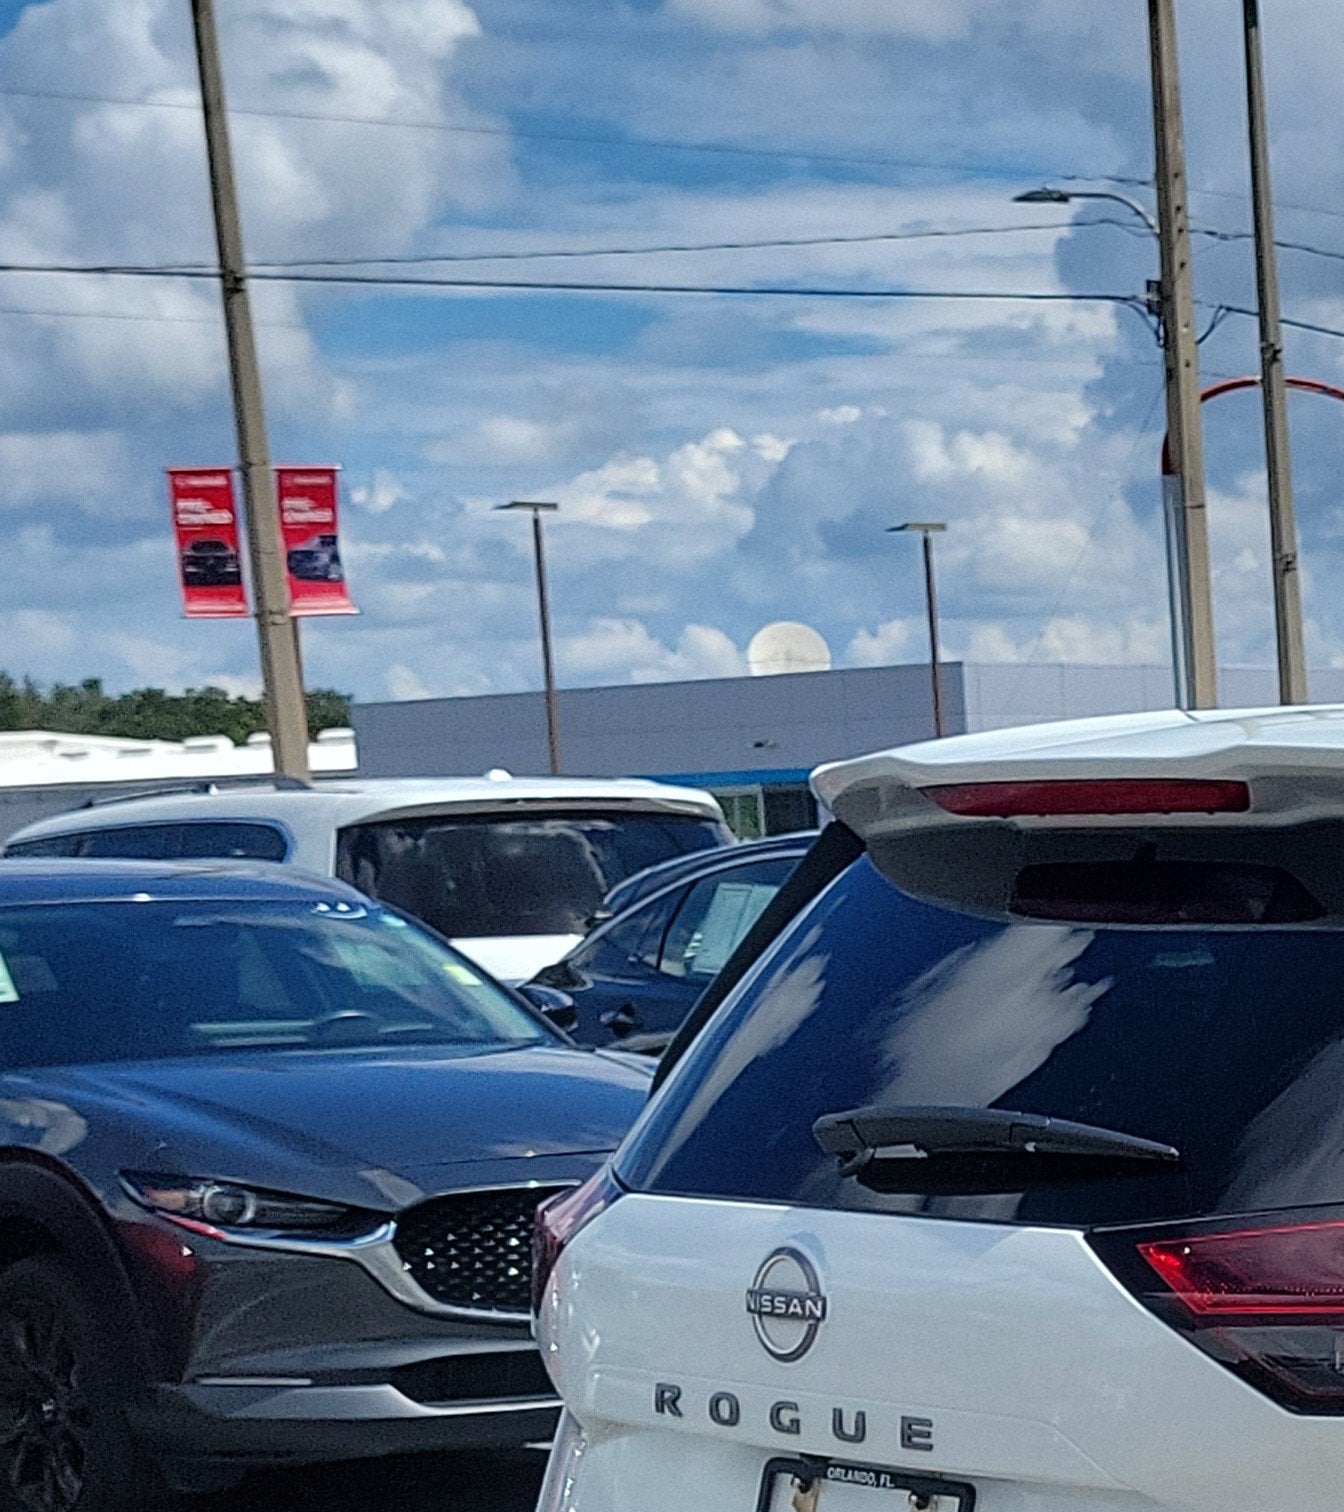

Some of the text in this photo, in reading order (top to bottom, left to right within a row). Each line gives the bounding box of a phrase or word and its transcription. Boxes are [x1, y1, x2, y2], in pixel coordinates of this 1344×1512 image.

[746, 1290, 823, 1318] NISSAN
[654, 1381, 934, 1452] ROGUE
[826, 1466, 878, 1489] ORLANDO,
